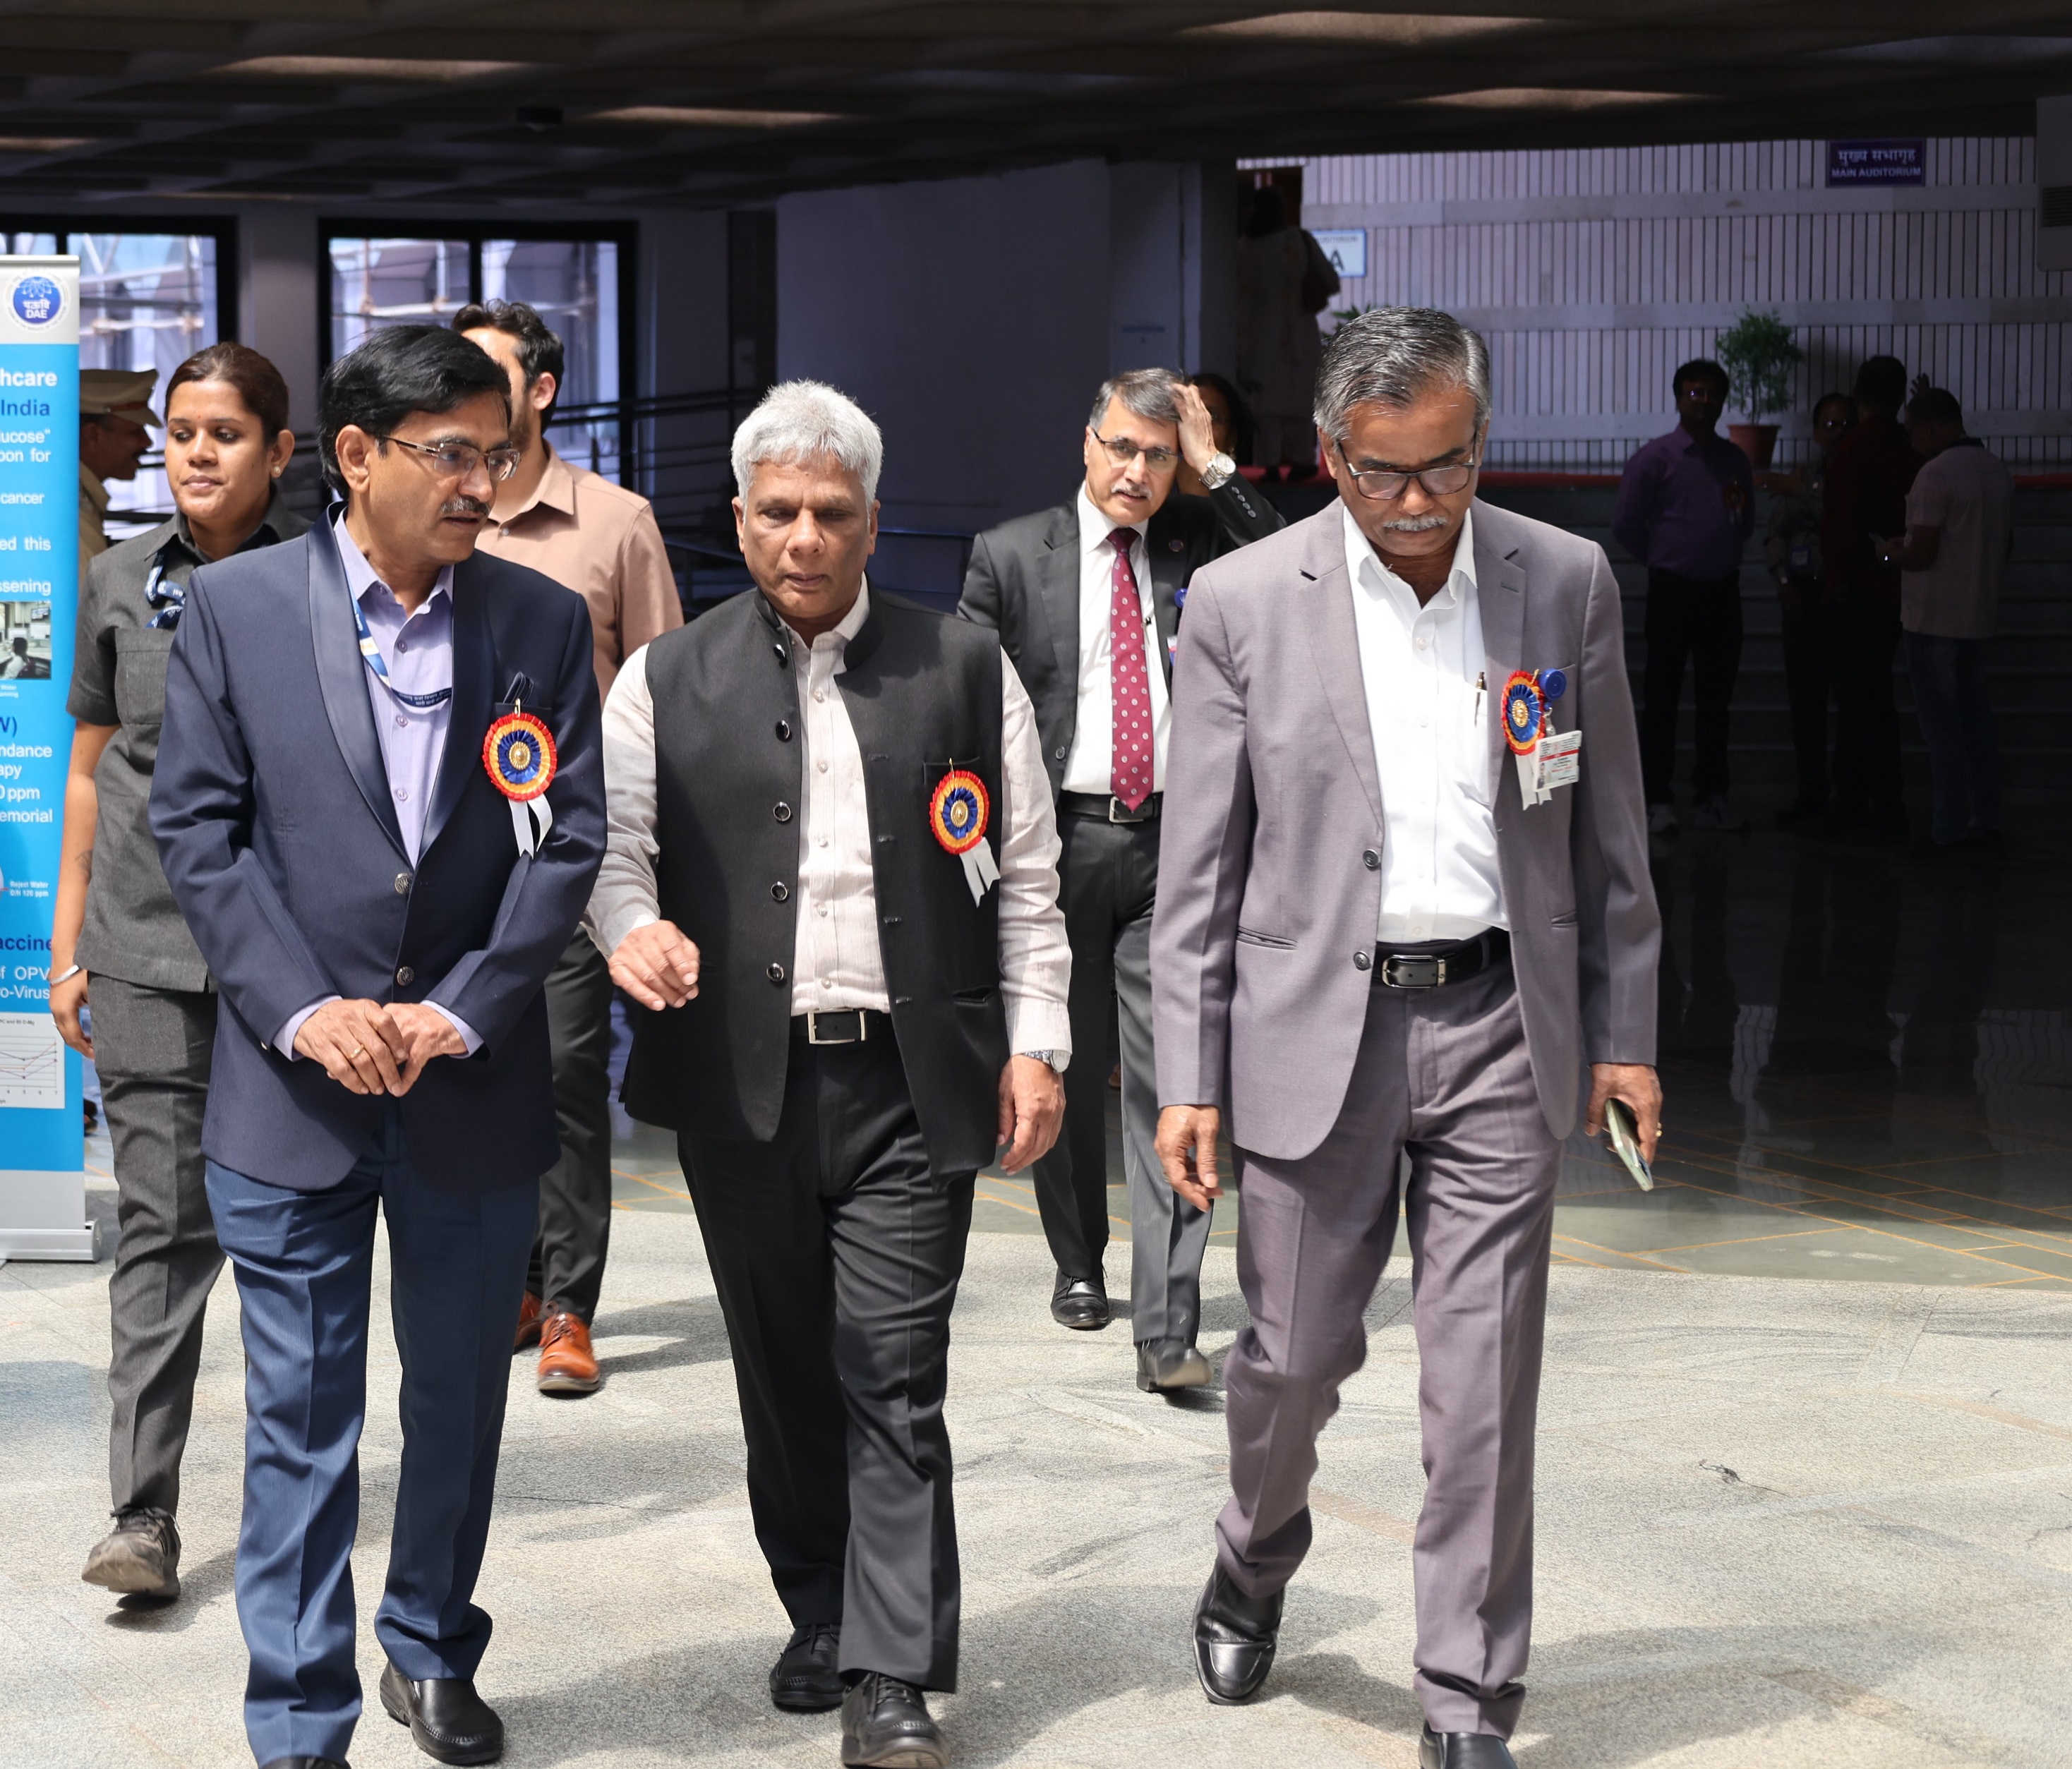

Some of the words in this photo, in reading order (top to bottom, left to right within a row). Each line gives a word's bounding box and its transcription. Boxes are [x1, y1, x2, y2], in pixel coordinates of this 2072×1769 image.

[1837, 149, 1867, 167] मुख्य
[1831, 168, 1857, 177] MAIN
[1858, 167, 1921, 177] AUDITORIUM
[25, 309, 48, 319] DAE
[0, 367, 58, 387] hcare
[1, 399, 50, 416] India
[30, 447, 52, 463] for
[1, 493, 45, 505] cancer
[24, 536, 52, 551] this
[8, 786, 41, 802] ppm
[14, 966, 50, 980] OPV
[0, 985, 50, 999] o-Virus
